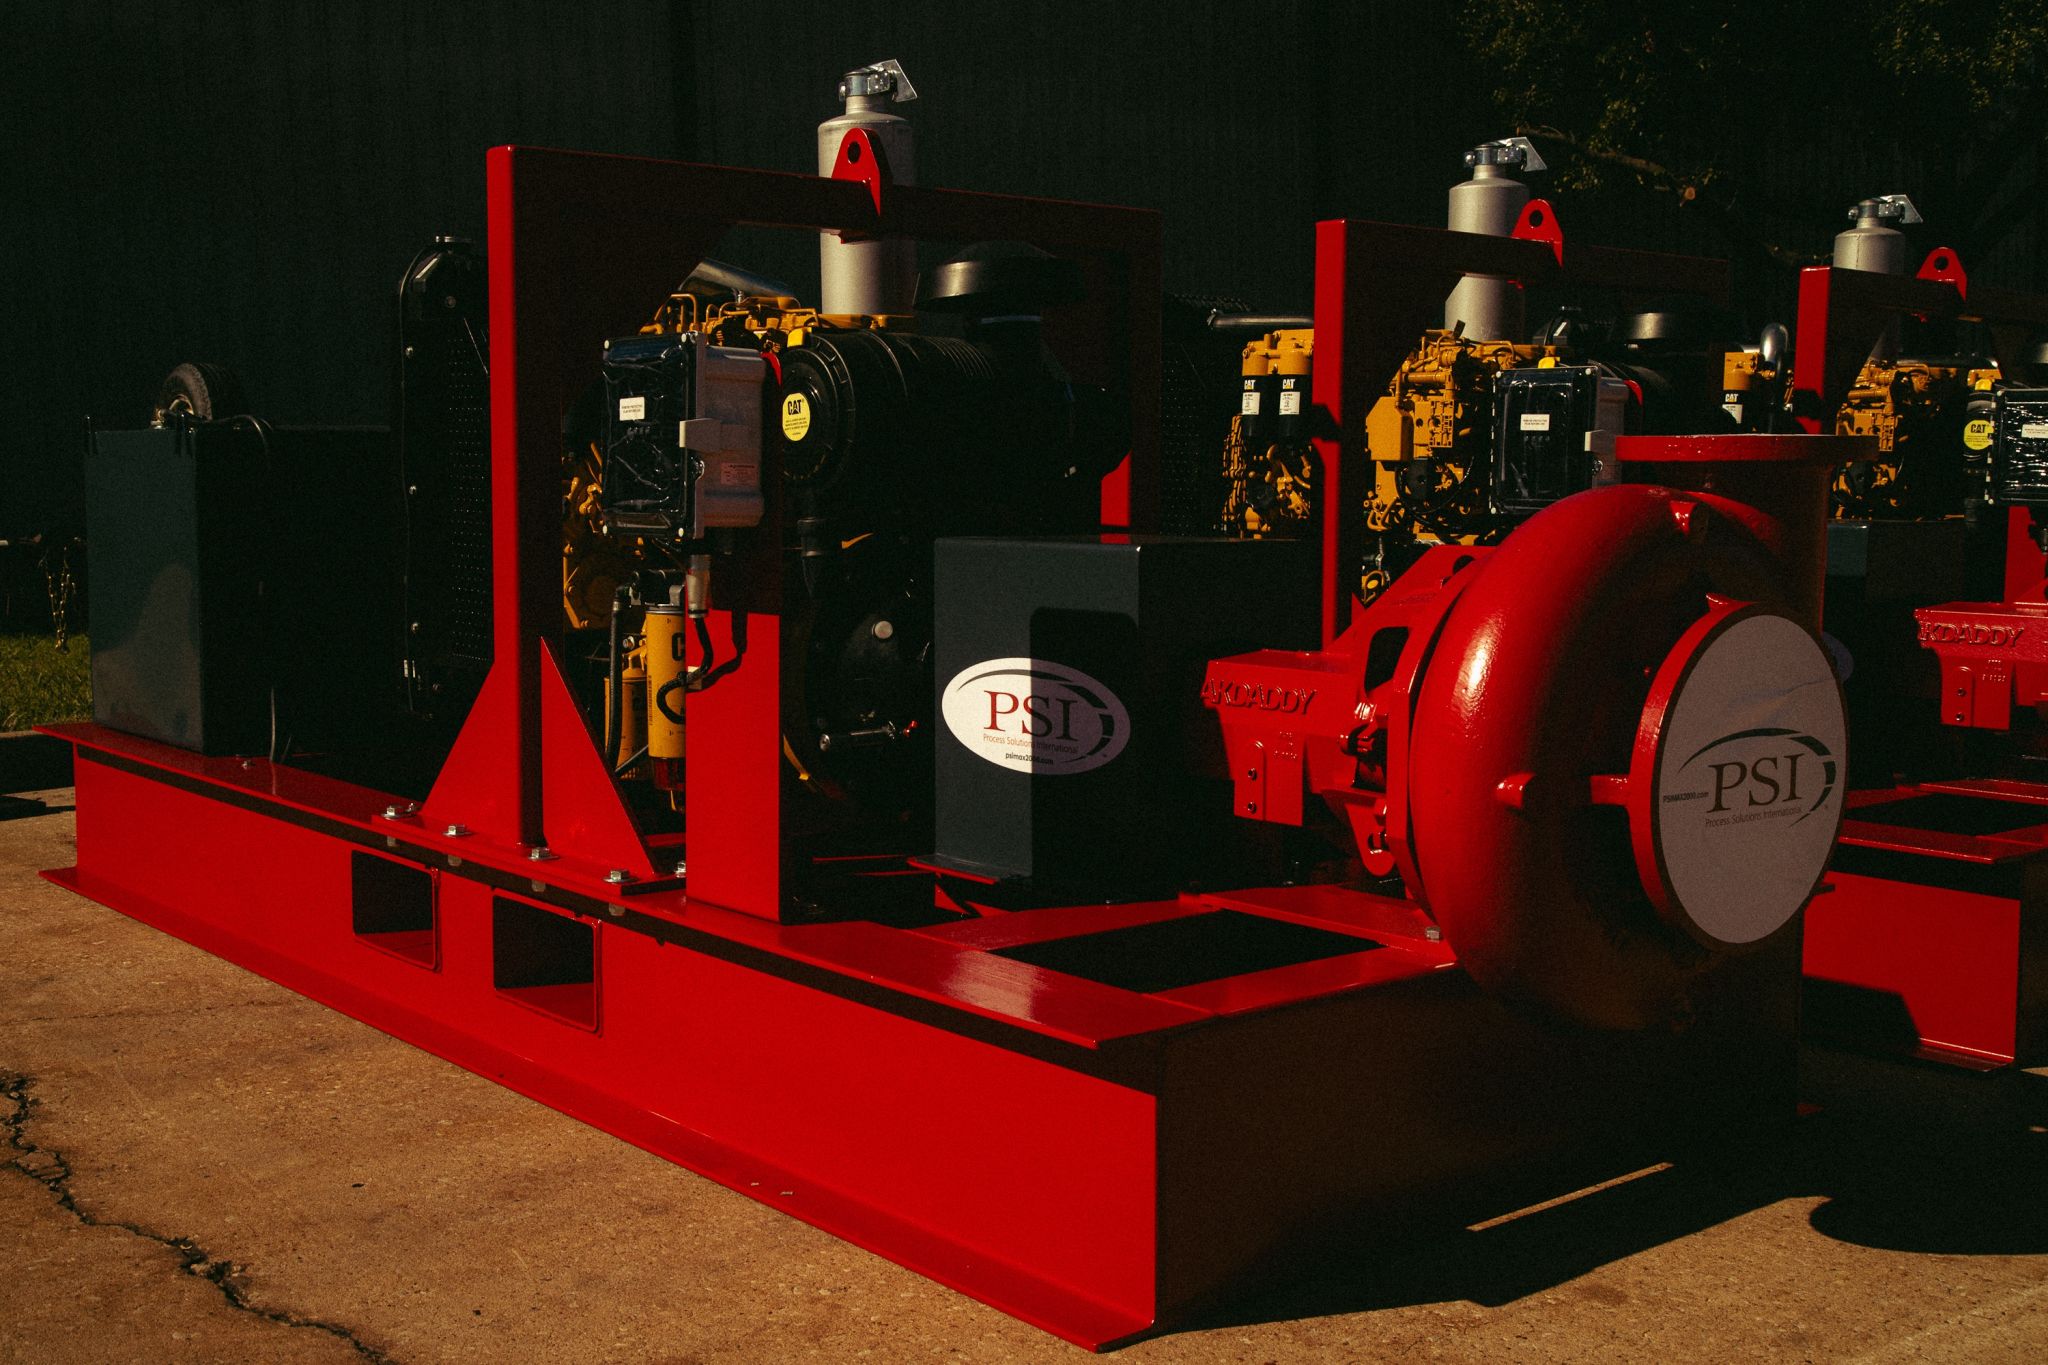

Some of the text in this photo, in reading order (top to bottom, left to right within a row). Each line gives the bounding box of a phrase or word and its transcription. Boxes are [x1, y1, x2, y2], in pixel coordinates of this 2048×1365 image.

[1245, 380, 1257, 390] CAT
[1283, 379, 1296, 390] CAT
[1725, 393, 1739, 403] CAT
[788, 399, 802, 415] CAT
[1971, 424, 1986, 433] CAT
[984, 690, 1079, 742] PSI
[983, 733, 1079, 754] Process Solutions International
[1707, 754, 1804, 813] PSI
[1706, 807, 1802, 826] Process Solutions International
